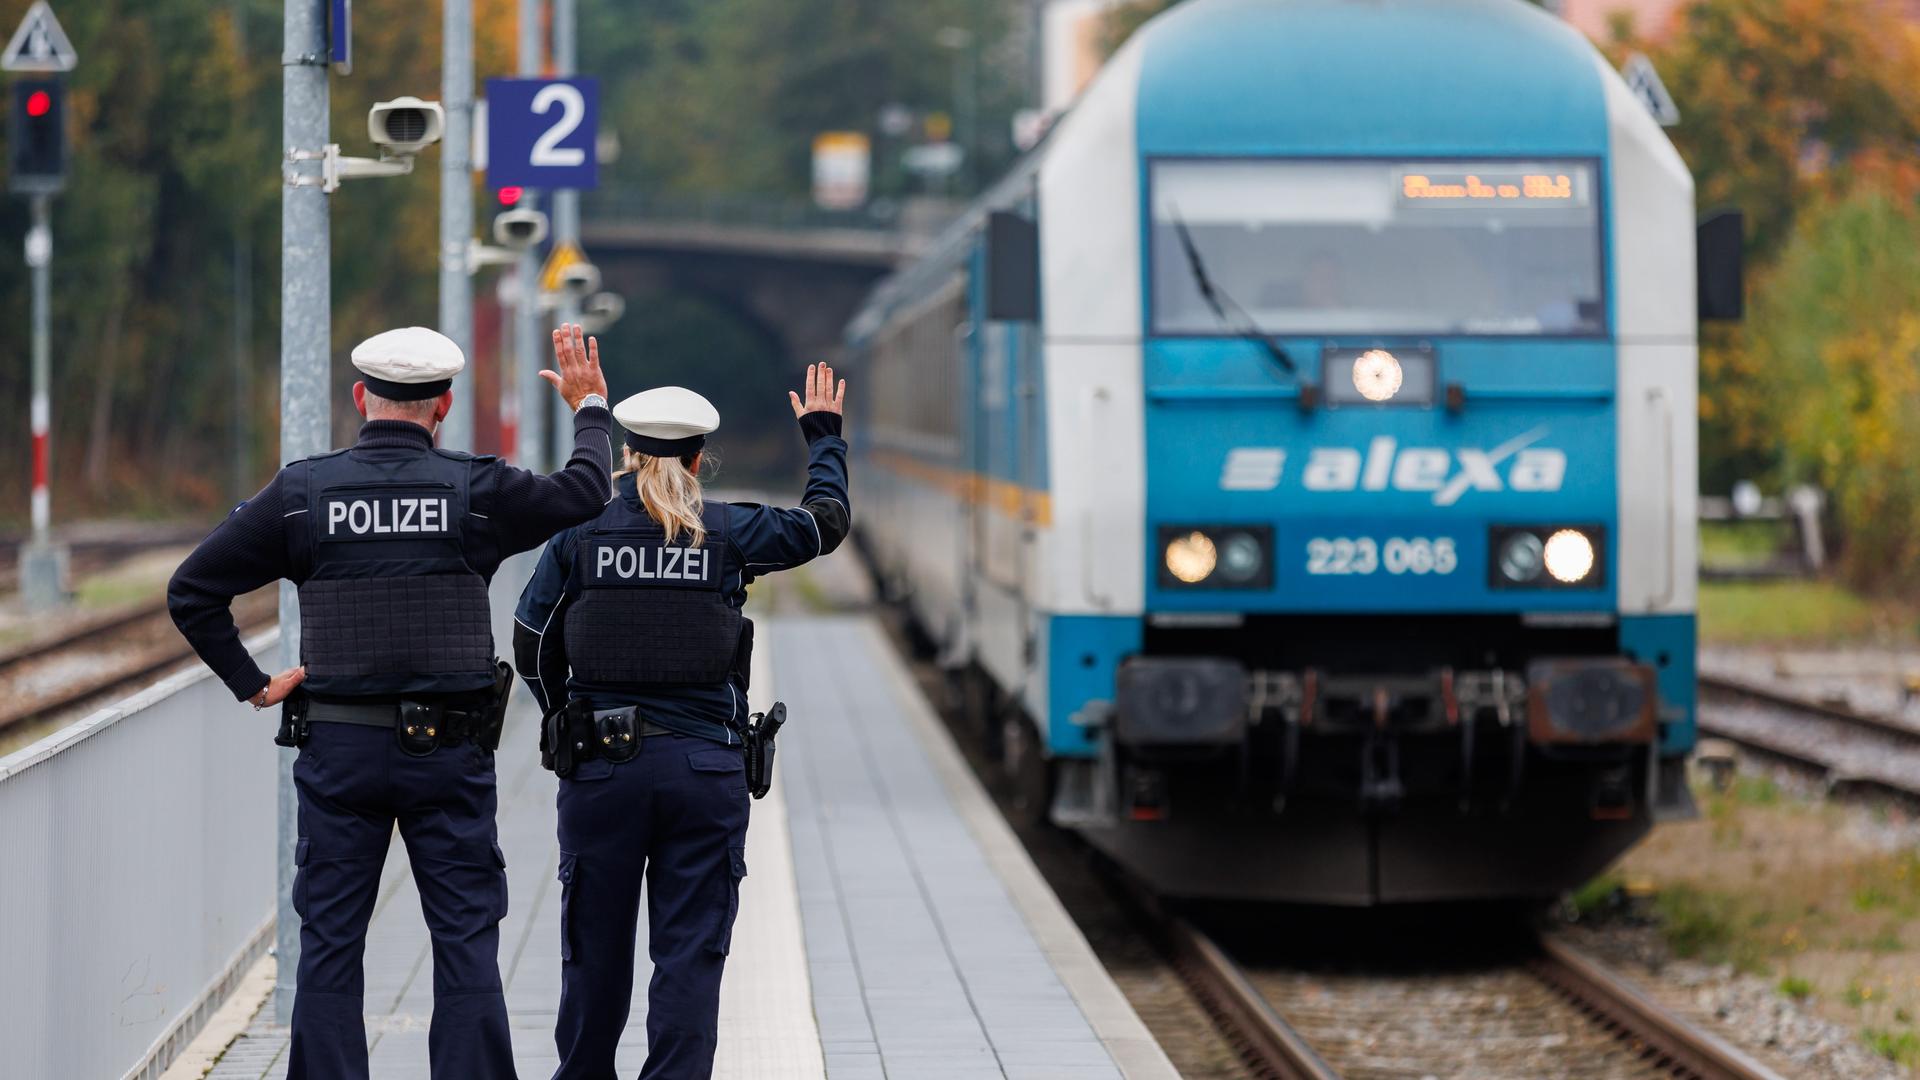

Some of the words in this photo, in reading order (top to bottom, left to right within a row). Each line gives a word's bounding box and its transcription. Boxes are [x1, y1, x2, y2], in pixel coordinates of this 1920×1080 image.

[530, 83, 585, 167] 2
[1303, 428, 1566, 505] alexa
[328, 498, 448, 535] POLIZEI
[596, 545, 709, 580] POLIZEI
[1306, 537, 1378, 575] 223
[1383, 537, 1457, 575] 065
